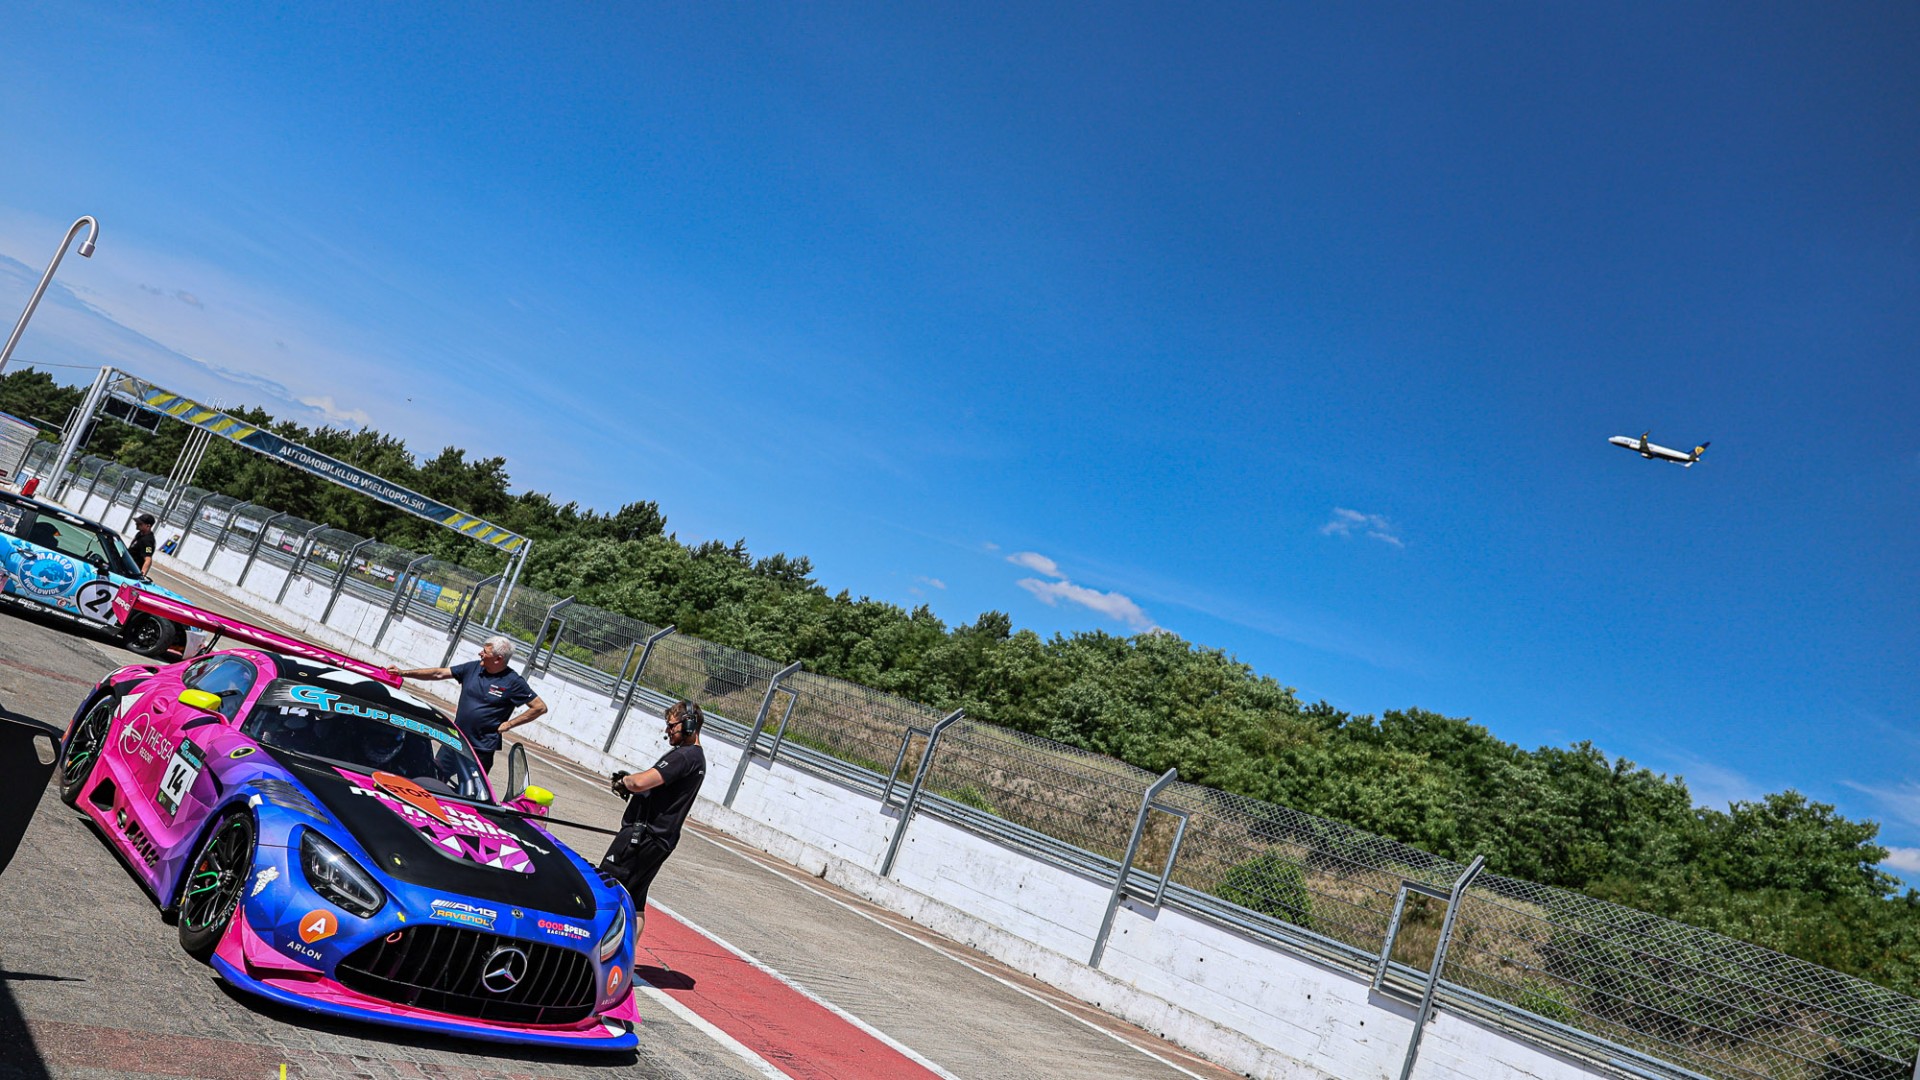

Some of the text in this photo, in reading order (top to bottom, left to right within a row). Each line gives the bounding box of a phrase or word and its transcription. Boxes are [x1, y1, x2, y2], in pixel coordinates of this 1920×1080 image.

[279, 445, 426, 511] AUTOMOBILKLUB WIELKOPOLSKI
[36, 552, 73, 570] MARGO
[23, 577, 60, 595] WORLDWIDE
[278, 705, 309, 718] 14
[334, 702, 463, 752] CUP SERIES
[145, 726, 163, 752] THE
[157, 738, 176, 764] SEA
[166, 763, 188, 797] 14
[382, 783, 433, 800] STOP
[436, 909, 490, 926] RAVENOL
[286, 940, 323, 961] ARLON
